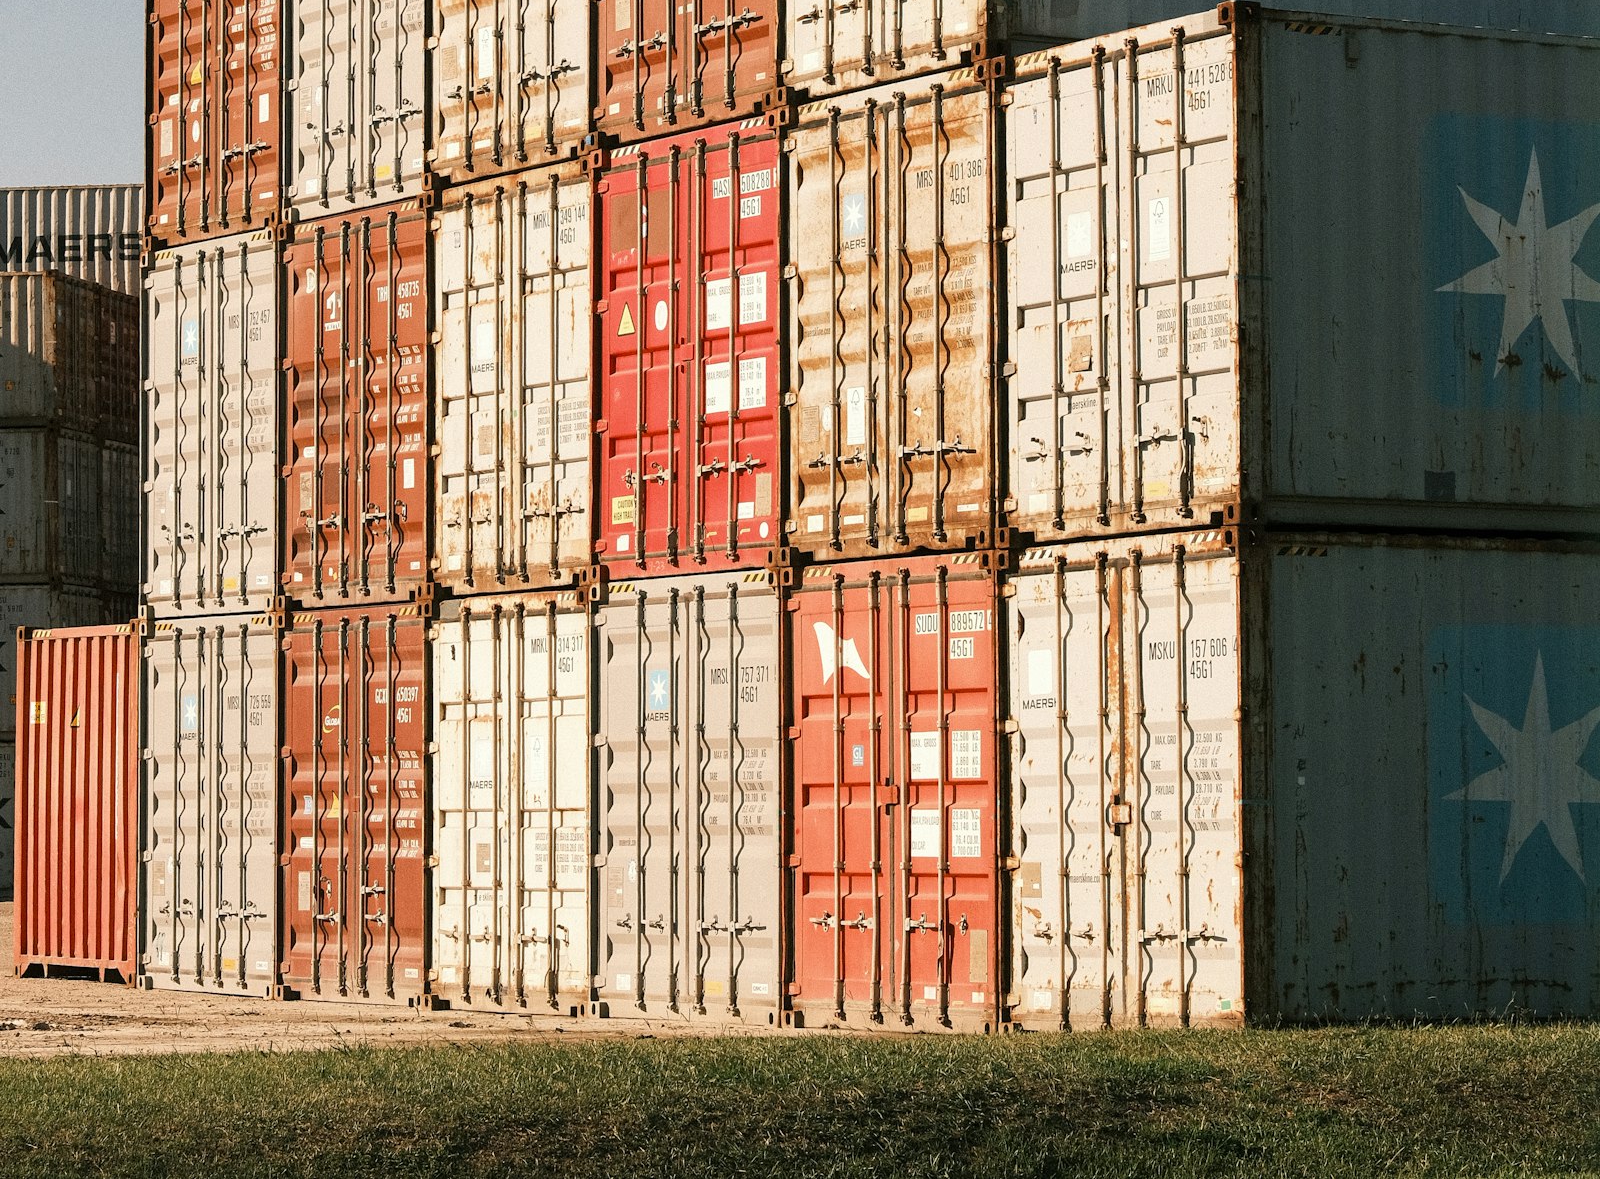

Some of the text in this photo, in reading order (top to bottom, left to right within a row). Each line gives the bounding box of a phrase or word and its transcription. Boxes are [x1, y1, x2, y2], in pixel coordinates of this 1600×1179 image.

[1147, 65, 1226, 98] MRKU 441 528
[1188, 90, 1212, 112] 45G1
[741, 171, 770, 192] 508288
[916, 159, 981, 189] MRS 401 386
[950, 186, 970, 205] 45G1
[560, 208, 572, 224] 349
[574, 205, 585, 223] 144
[742, 198, 760, 217] 45G1
[560, 227, 576, 245] 45G1
[842, 238, 866, 251] AERS
[0, 234, 142, 264] MAERS
[377, 286, 388, 303] TRH
[398, 302, 413, 319] 45G1
[229, 315, 239, 330] MRS
[472, 363, 494, 373] MAERS
[916, 612, 984, 633] SUDU 889572
[558, 637, 570, 654] 314
[572, 635, 583, 652] 317
[951, 640, 973, 657] 45G1
[1149, 637, 1228, 661] MSKU 157 606
[558, 657, 574, 673] 45G1
[1190, 660, 1213, 679] 45G1
[741, 667, 754, 683] 757
[756, 666, 769, 682] 371
[397, 687, 418, 703] 650397
[741, 687, 758, 703] 45G1
[397, 708, 412, 723] 45G1
[644, 712, 669, 722] MAERS
[1155, 735, 1176, 745] MAX.GRO
[1215, 733, 1222, 742] KG
[1150, 760, 1161, 770] TARE
[470, 780, 493, 789] MAERS
[1155, 785, 1174, 795] PAYLOAD
[1151, 810, 1162, 820] CUBE
